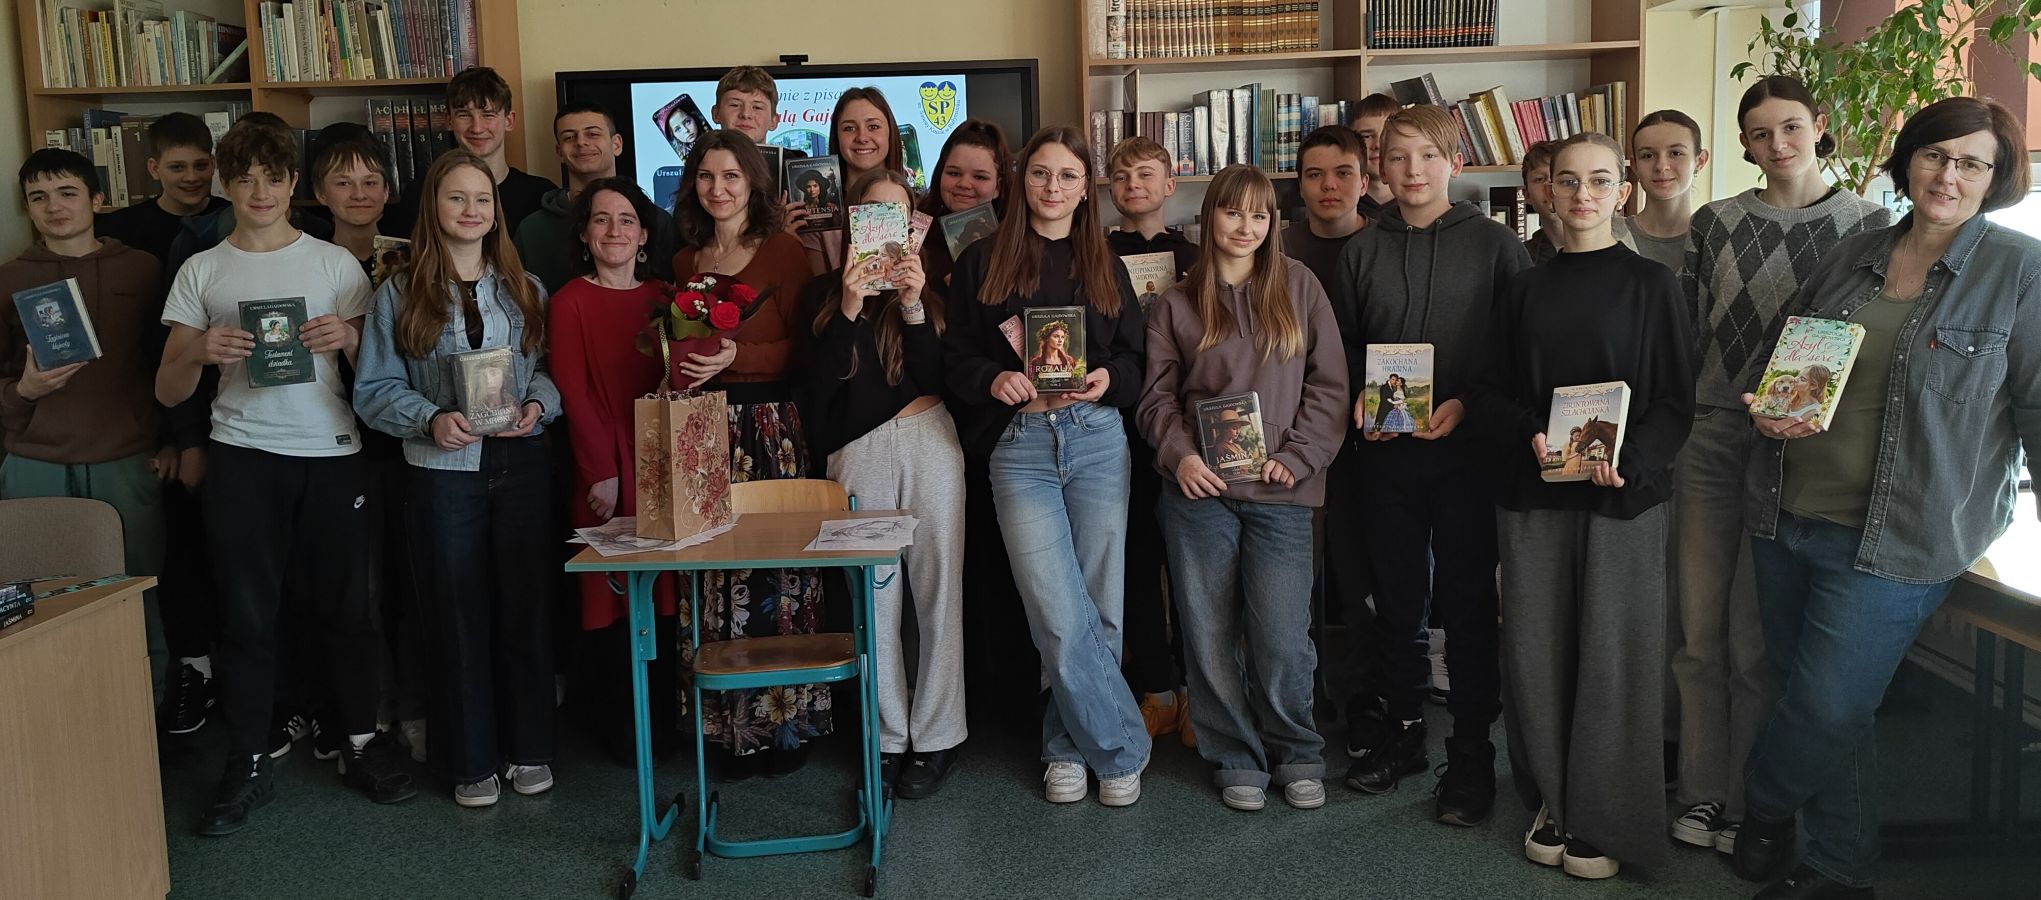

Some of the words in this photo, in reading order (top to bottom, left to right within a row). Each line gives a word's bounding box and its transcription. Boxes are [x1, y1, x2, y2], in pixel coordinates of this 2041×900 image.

[780, 89, 800, 101] nie
[804, 92, 811, 101] z
[928, 100, 950, 115] SP
[779, 109, 797, 127] lą
[802, 108, 831, 126] Gaj
[934, 115, 946, 126] 43
[1184, 115, 1193, 143] Oxford
[134, 131, 141, 142] 1
[382, 134, 387, 143] 1
[400, 133, 407, 142] 2
[419, 134, 426, 142] 3
[437, 132, 443, 141] 4
[1517, 202, 1525, 242] ADEUSZ
[1787, 335, 1824, 357] Azyl
[264, 349, 294, 360] Testament
[1783, 349, 1802, 362] dla
[1807, 354, 1834, 362] serc
[1377, 358, 1418, 366] ZAKOCHANA
[1035, 365, 1074, 373] ROZALIA
[1382, 365, 1413, 373] HRABINA
[1563, 398, 1610, 410] ZBUNTOWANA
[1216, 450, 1254, 464] JAŚMINA
